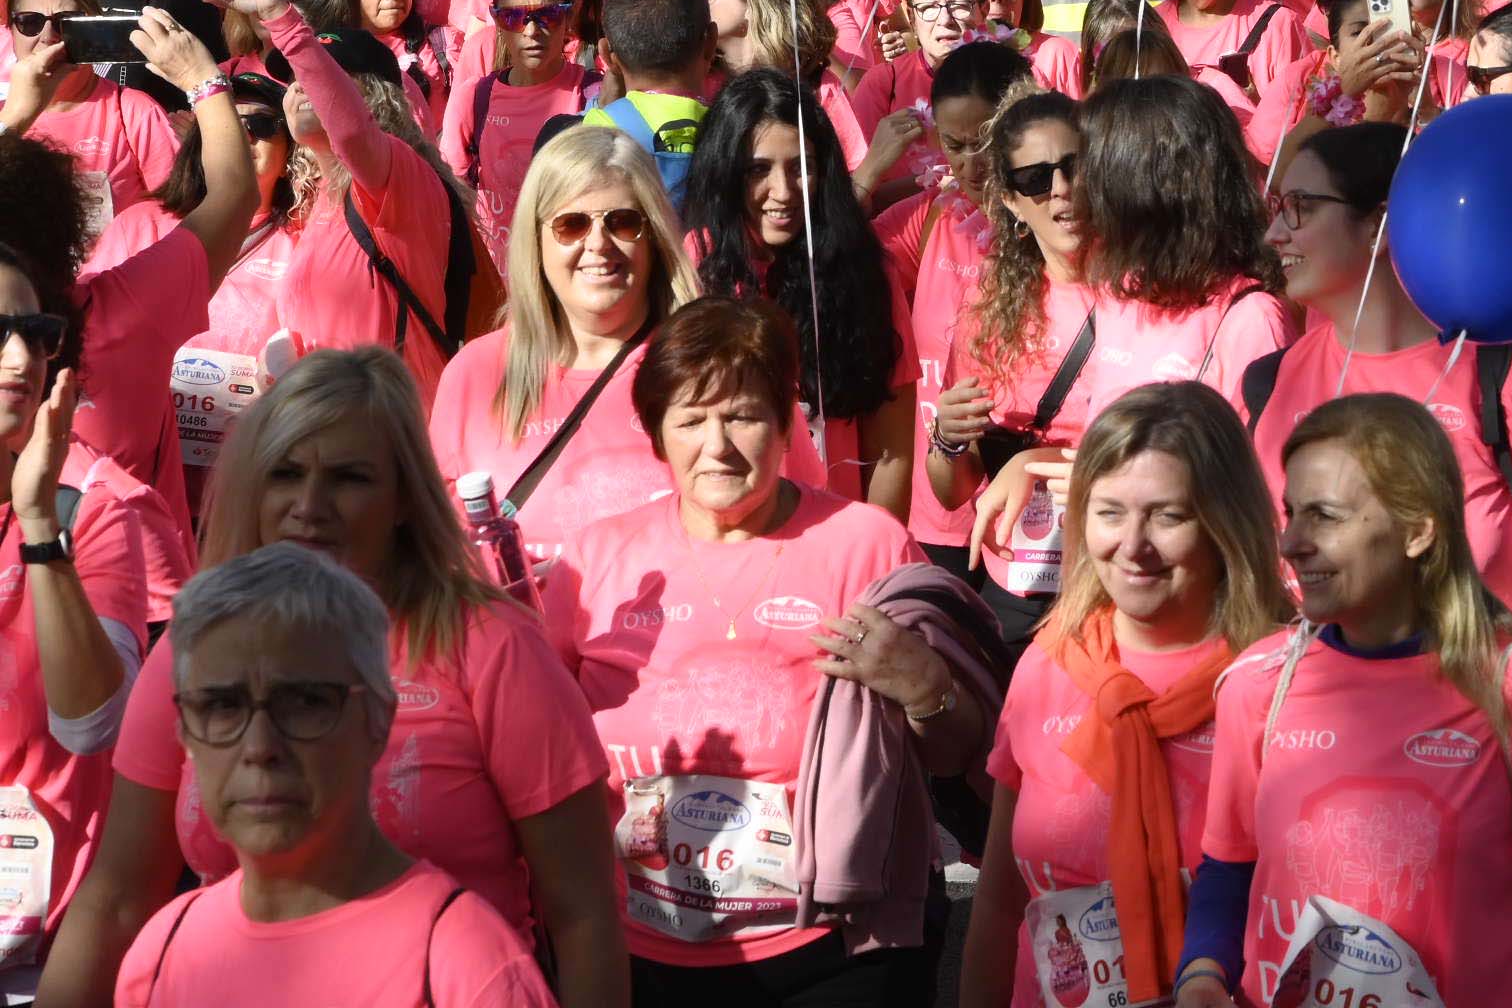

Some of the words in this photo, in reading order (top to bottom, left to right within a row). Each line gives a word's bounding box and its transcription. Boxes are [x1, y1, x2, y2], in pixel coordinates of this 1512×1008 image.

[174, 365, 221, 381] ASTURIANA
[173, 392, 215, 412] 016
[623, 602, 692, 632] OYSHO
[758, 605, 820, 624] ASTURIANA
[1270, 729, 1336, 751] YSHO
[1408, 740, 1479, 760] ASTURIANA
[677, 801, 746, 823] ASTURIANA
[673, 842, 734, 871] 016
[684, 874, 721, 893] 1366
[684, 894, 698, 906] DE
[699, 897, 713, 909] LA
[714, 901, 753, 912] MUJER
[1321, 933, 1395, 969] ASTURIANA
